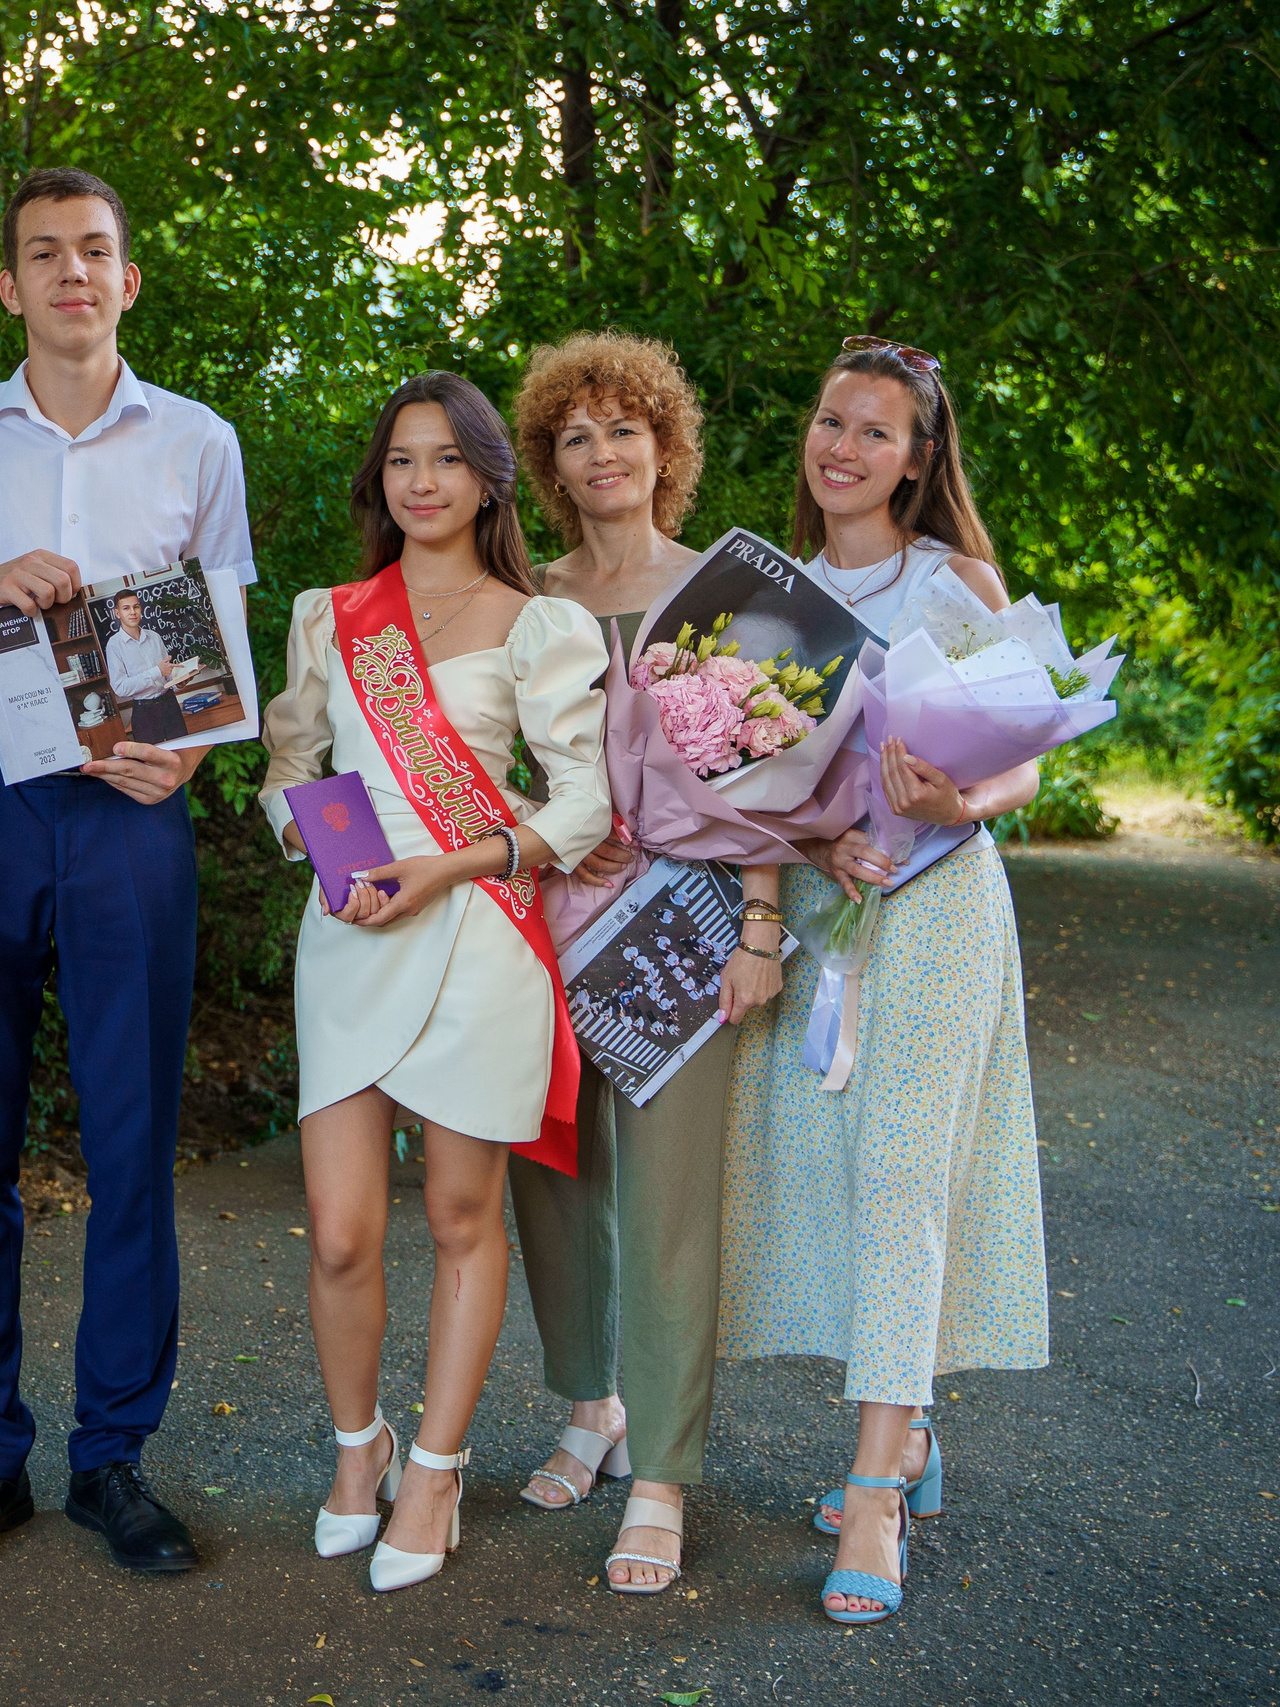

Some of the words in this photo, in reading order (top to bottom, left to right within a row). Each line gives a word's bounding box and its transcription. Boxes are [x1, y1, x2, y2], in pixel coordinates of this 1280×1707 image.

[725, 538, 796, 594] PRADA
[2, 626, 21, 636] ЕГОР
[8, 694, 24, 704] МАОУ
[25, 691, 38, 700] СОШ
[30, 697, 49, 707] КЛАСС
[39, 754, 57, 765] 2023
